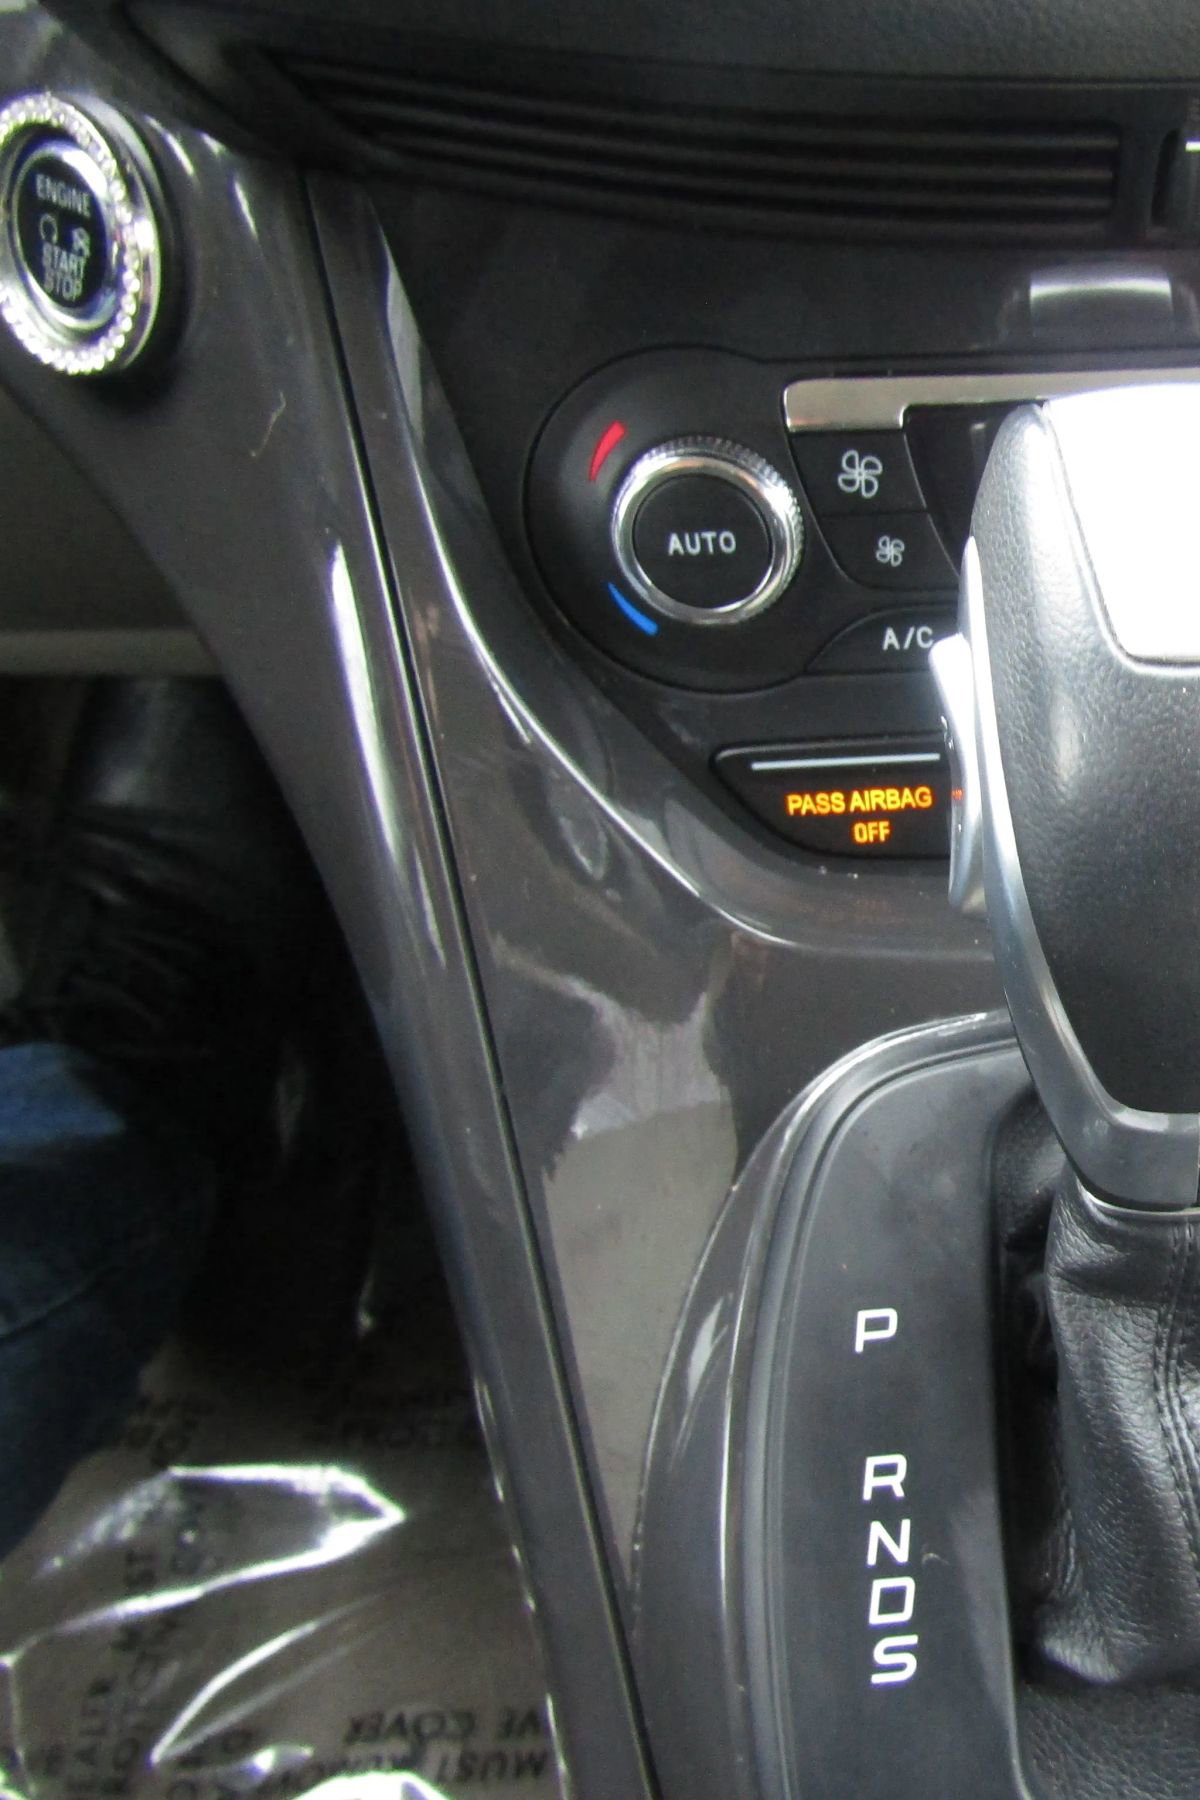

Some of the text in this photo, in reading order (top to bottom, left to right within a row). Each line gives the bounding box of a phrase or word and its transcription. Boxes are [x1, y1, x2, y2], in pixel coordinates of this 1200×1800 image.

[35, 173, 91, 218] ENGINE
[42, 241, 85, 280] START
[44, 266, 83, 301] STOP
[668, 531, 737, 556] AUTO
[882, 626, 934, 650] A/C
[786, 785, 933, 816] PASS AIRBAG
[853, 820, 891, 844] OFF
[855, 1308, 898, 1353] P
[863, 1454, 907, 1501] R
[867, 1519, 911, 1566] N
[869, 1577, 915, 1626] D
[871, 1635, 919, 1685] S
